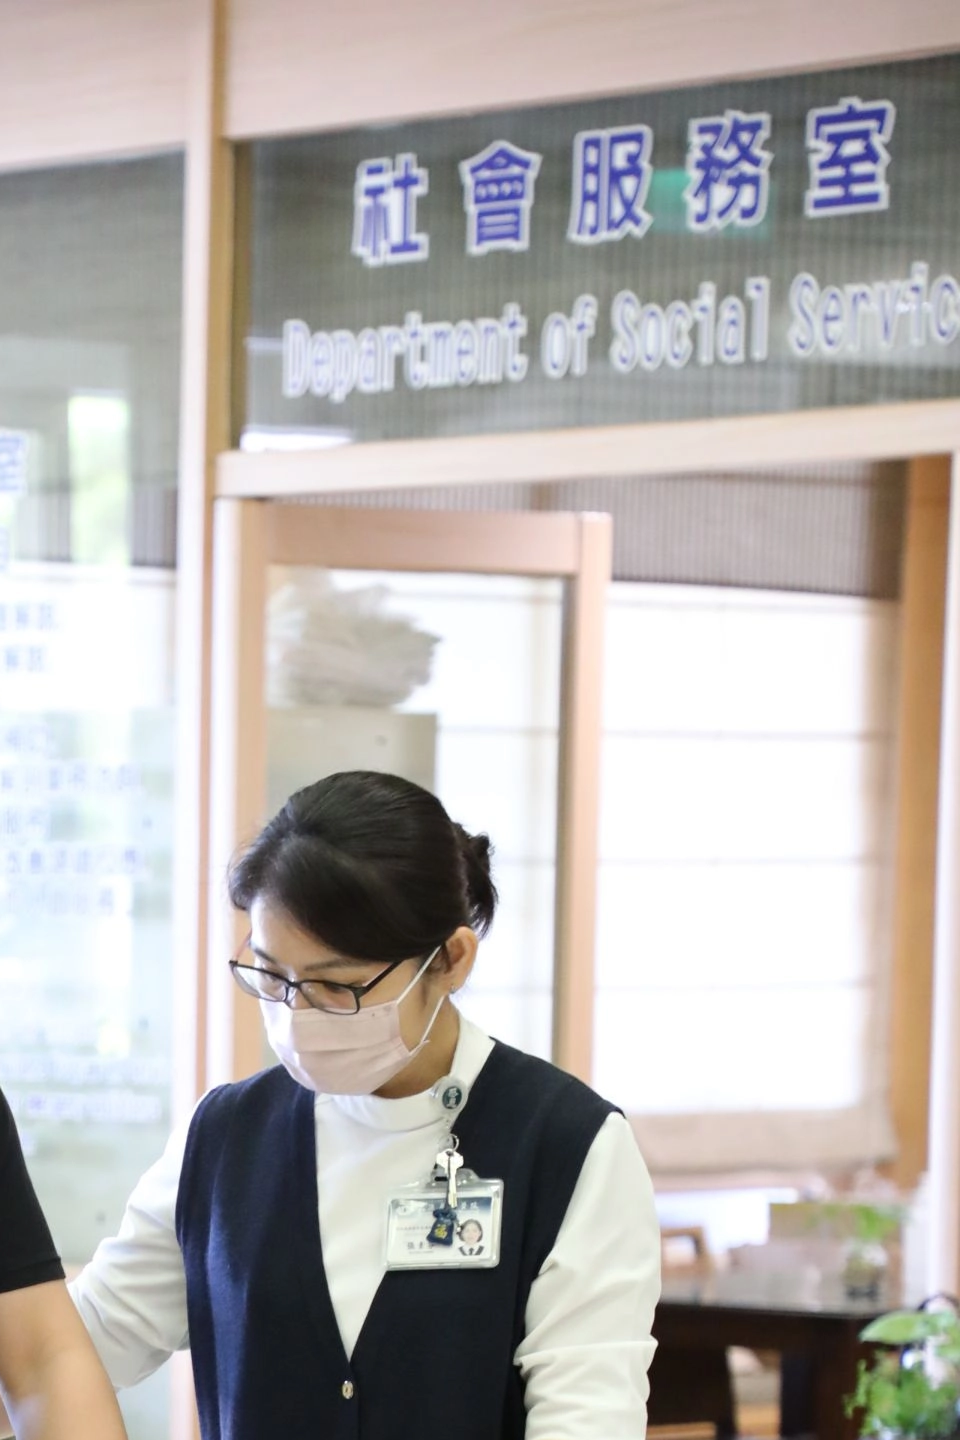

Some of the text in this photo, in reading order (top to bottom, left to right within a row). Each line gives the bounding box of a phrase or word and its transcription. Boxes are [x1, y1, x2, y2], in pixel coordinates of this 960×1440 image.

[352, 97, 896, 266] 社會服務室
[282, 302, 528, 402] Department
[541, 294, 598, 380] of
[610, 275, 770, 375] Social
